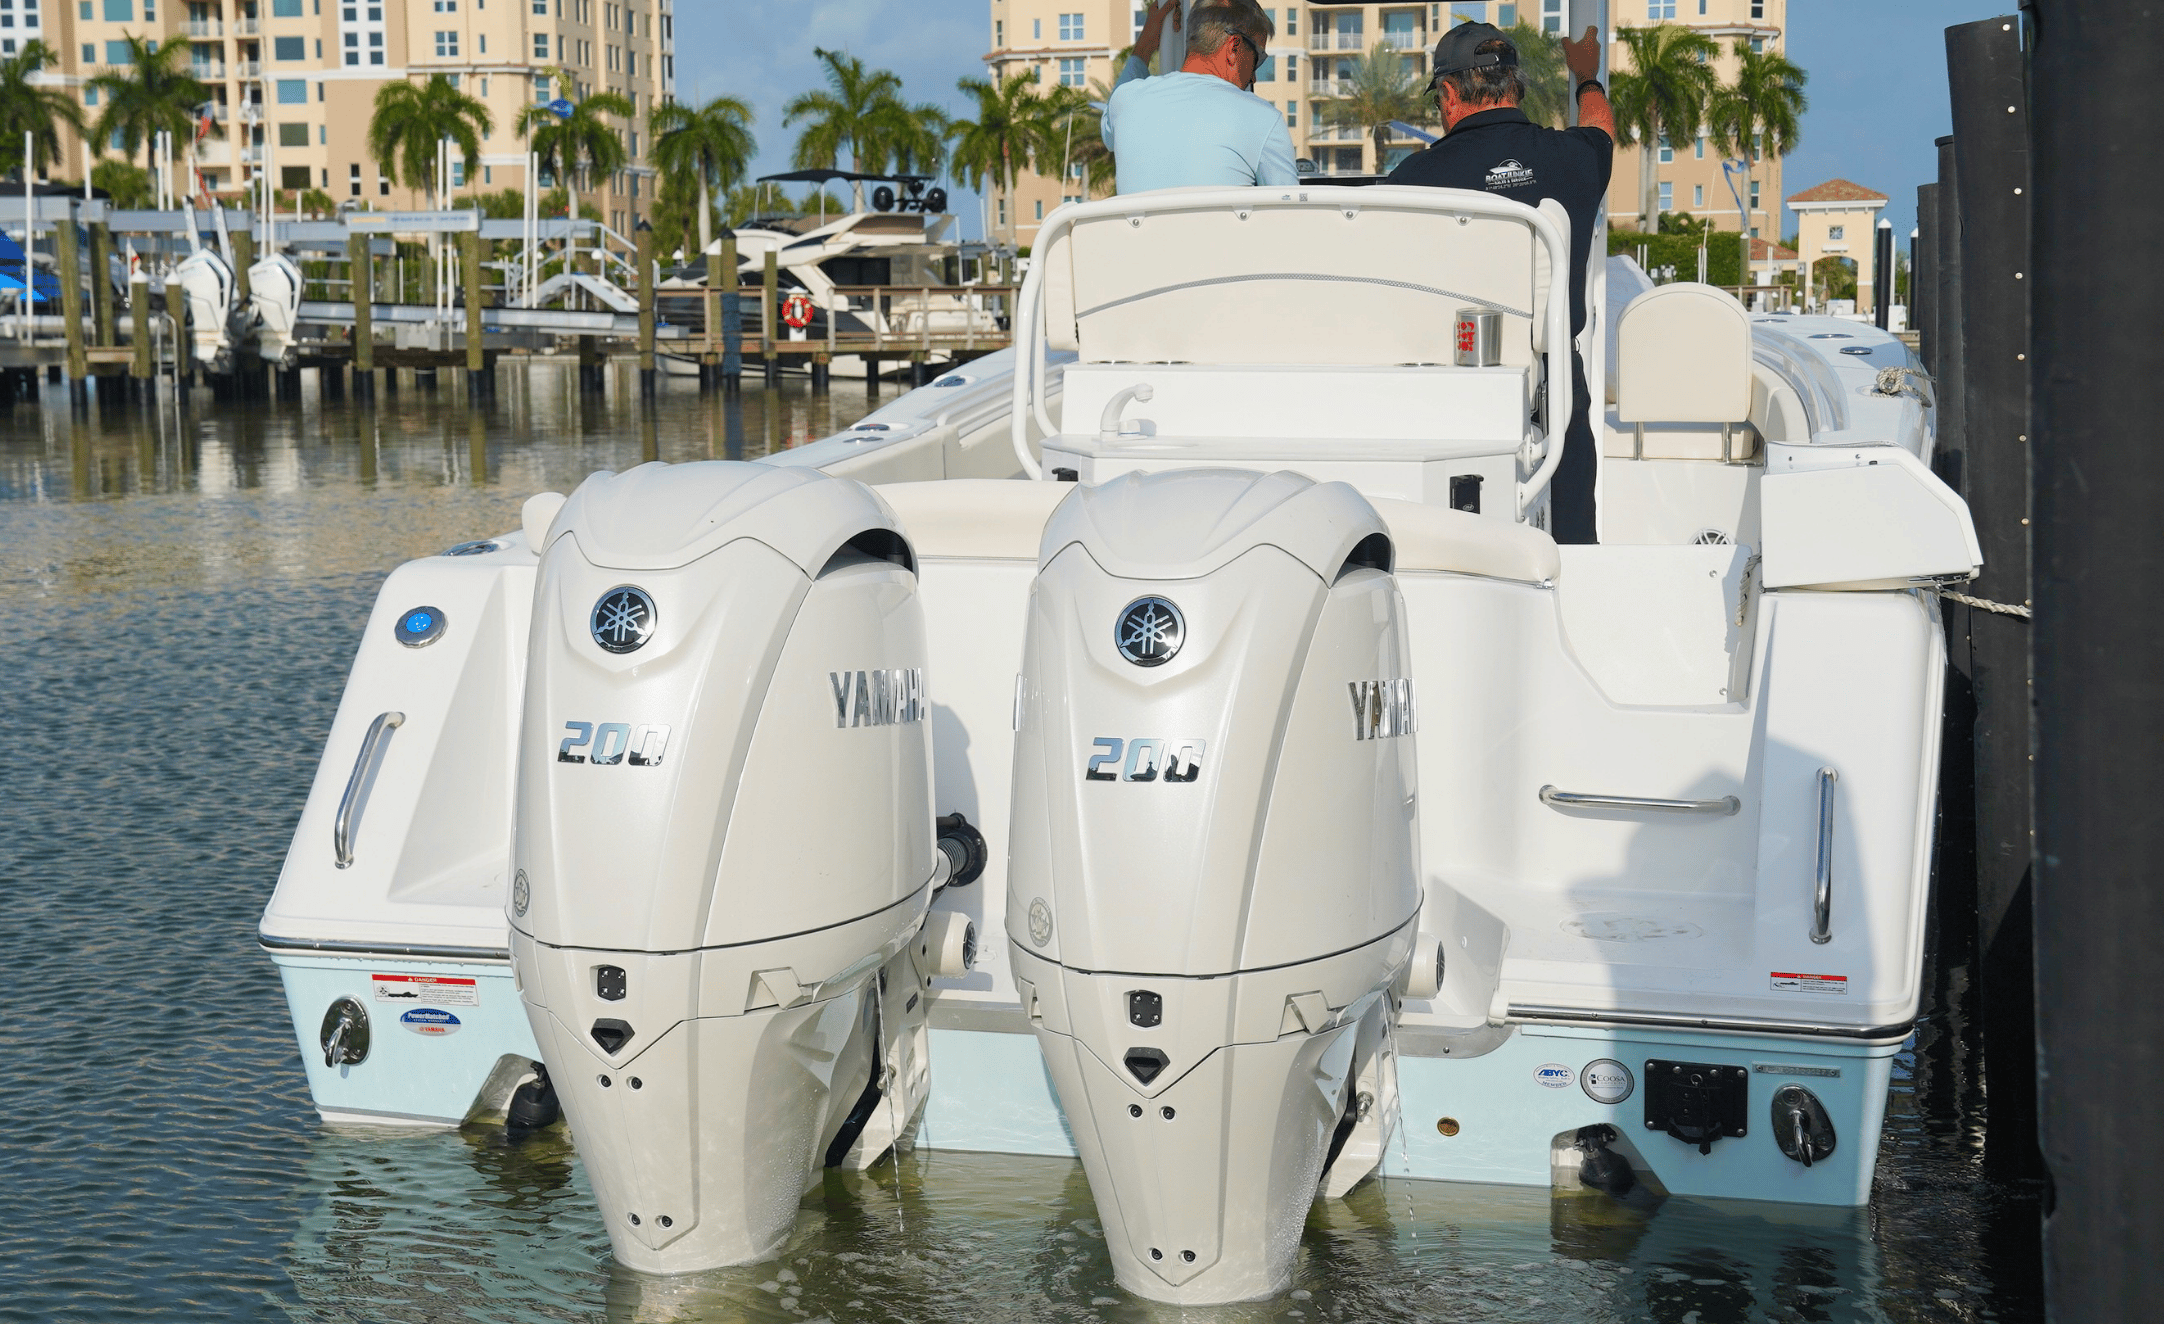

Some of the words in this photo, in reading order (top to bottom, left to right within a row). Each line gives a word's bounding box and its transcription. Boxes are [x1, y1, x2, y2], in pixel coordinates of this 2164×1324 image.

[557, 720, 671, 767] 200
[1085, 737, 1206, 783] 200
[1596, 1074, 1626, 1082] COOSA
